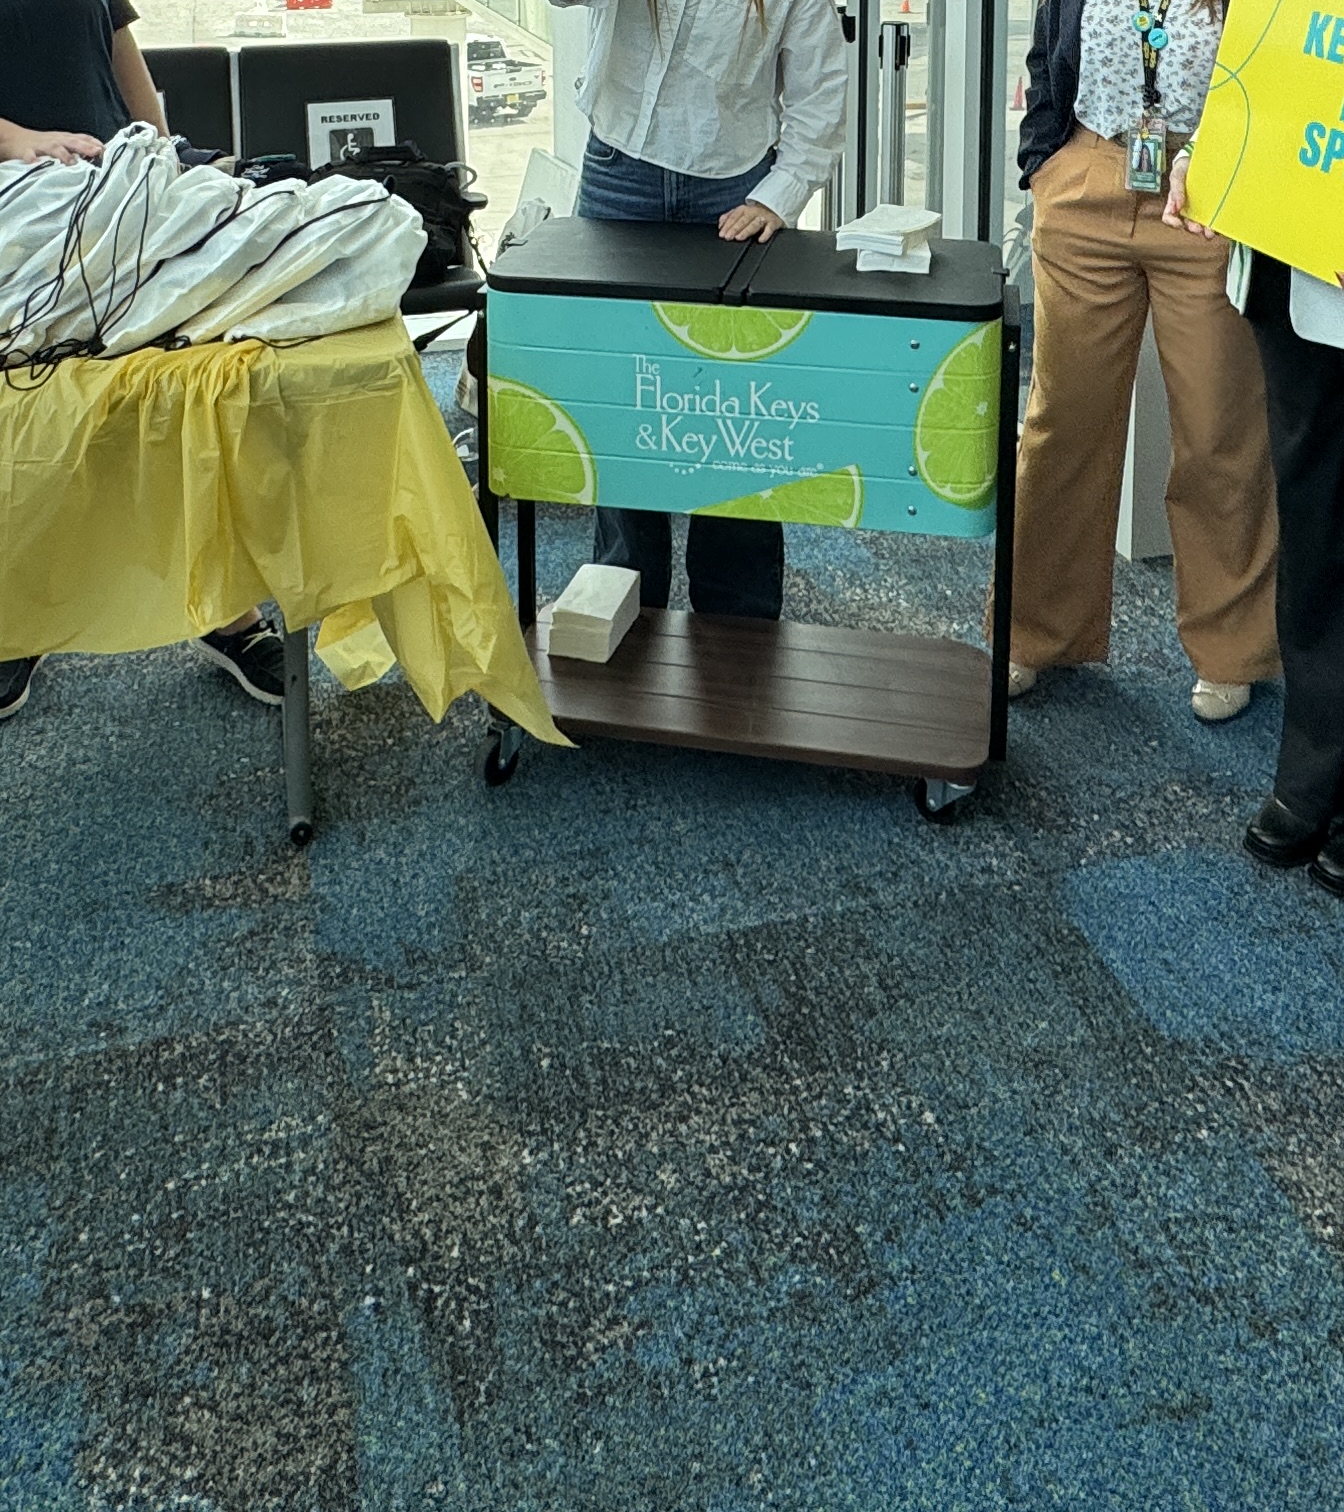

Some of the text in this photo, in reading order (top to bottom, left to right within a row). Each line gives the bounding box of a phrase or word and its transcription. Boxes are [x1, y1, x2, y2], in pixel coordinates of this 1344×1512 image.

[321, 112, 380, 124] RESERVED
[632, 354, 660, 375] The
[635, 374, 821, 430] Florida Keys
[716, 418, 794, 461] West
